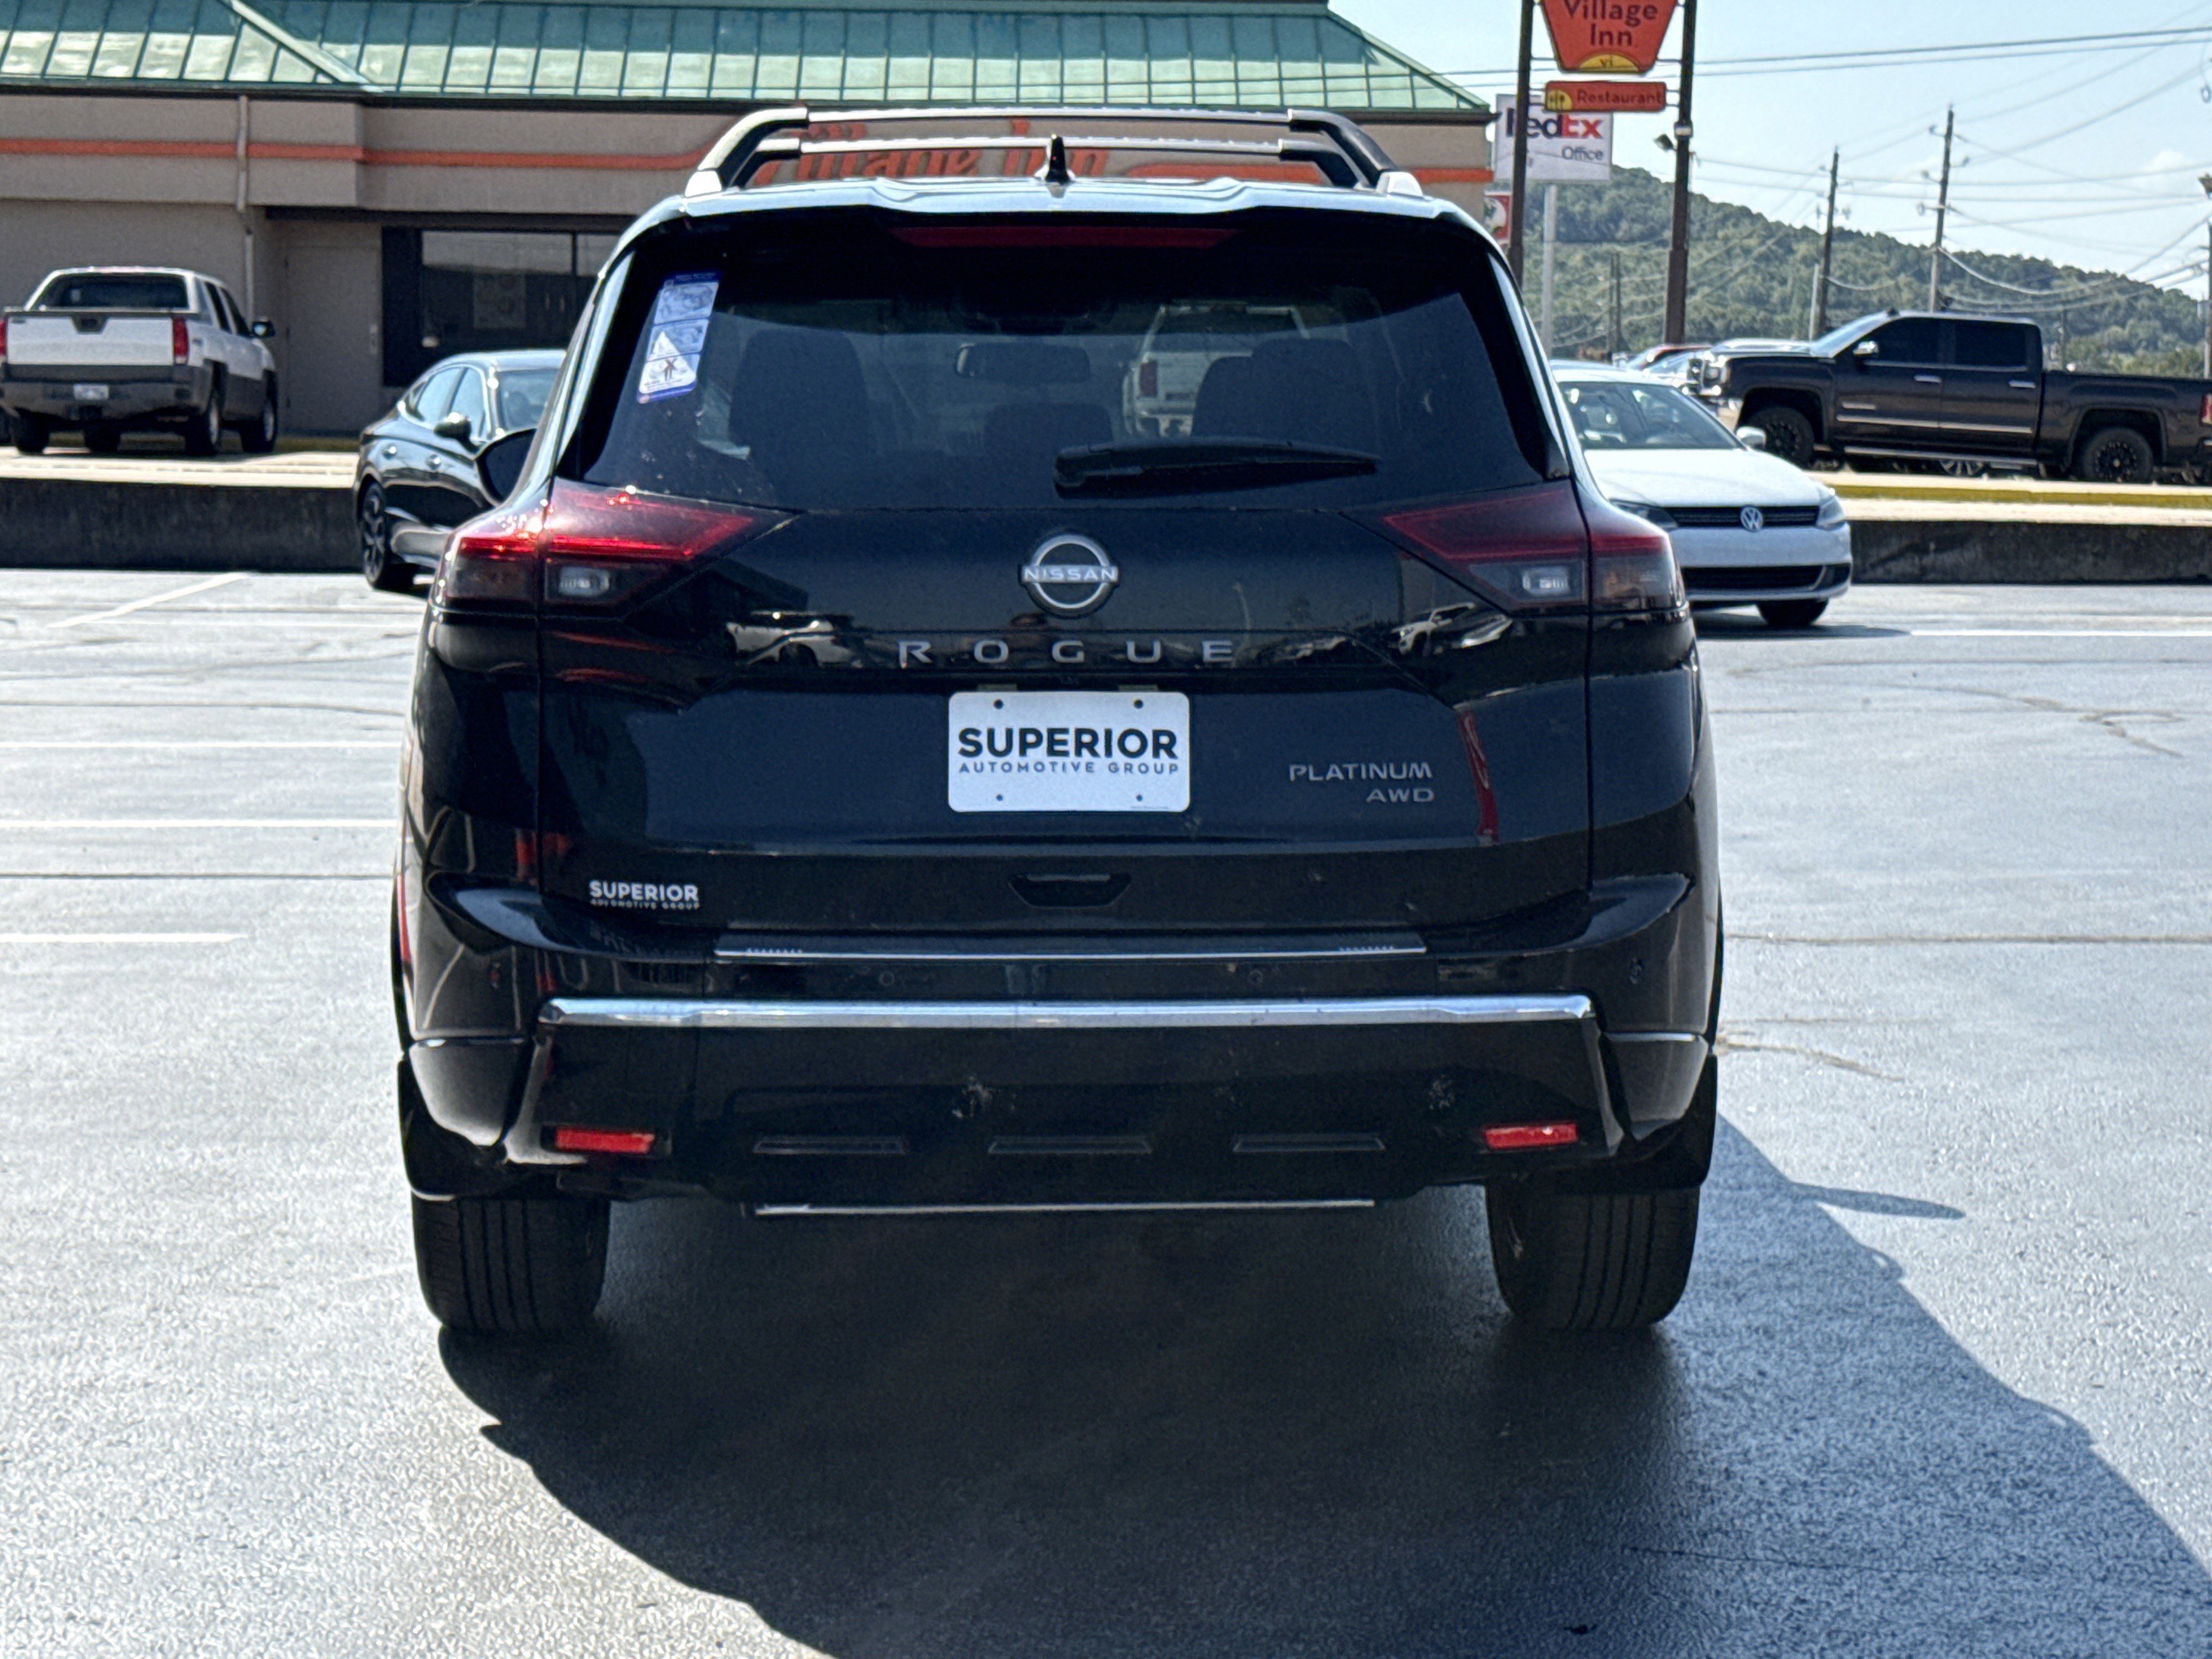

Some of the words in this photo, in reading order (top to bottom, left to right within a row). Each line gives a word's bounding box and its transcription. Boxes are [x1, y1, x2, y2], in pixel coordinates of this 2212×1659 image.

[1565, 0, 1658, 27] Village
[1590, 24, 1633, 47] Inn
[1577, 88, 1662, 105] Restaurant
[1562, 145, 1604, 161] Office
[1024, 567, 1117, 582] NISSAN
[898, 640, 1234, 665] ROGUE
[958, 727, 1179, 760] SUPERIOR
[958, 761, 1096, 774] AUTOMOTIVE
[1108, 761, 1179, 775] GROUP
[1289, 761, 1434, 782] PLATINUM
[1365, 787, 1435, 803] AWD
[589, 879, 699, 902] SUPERIOR
